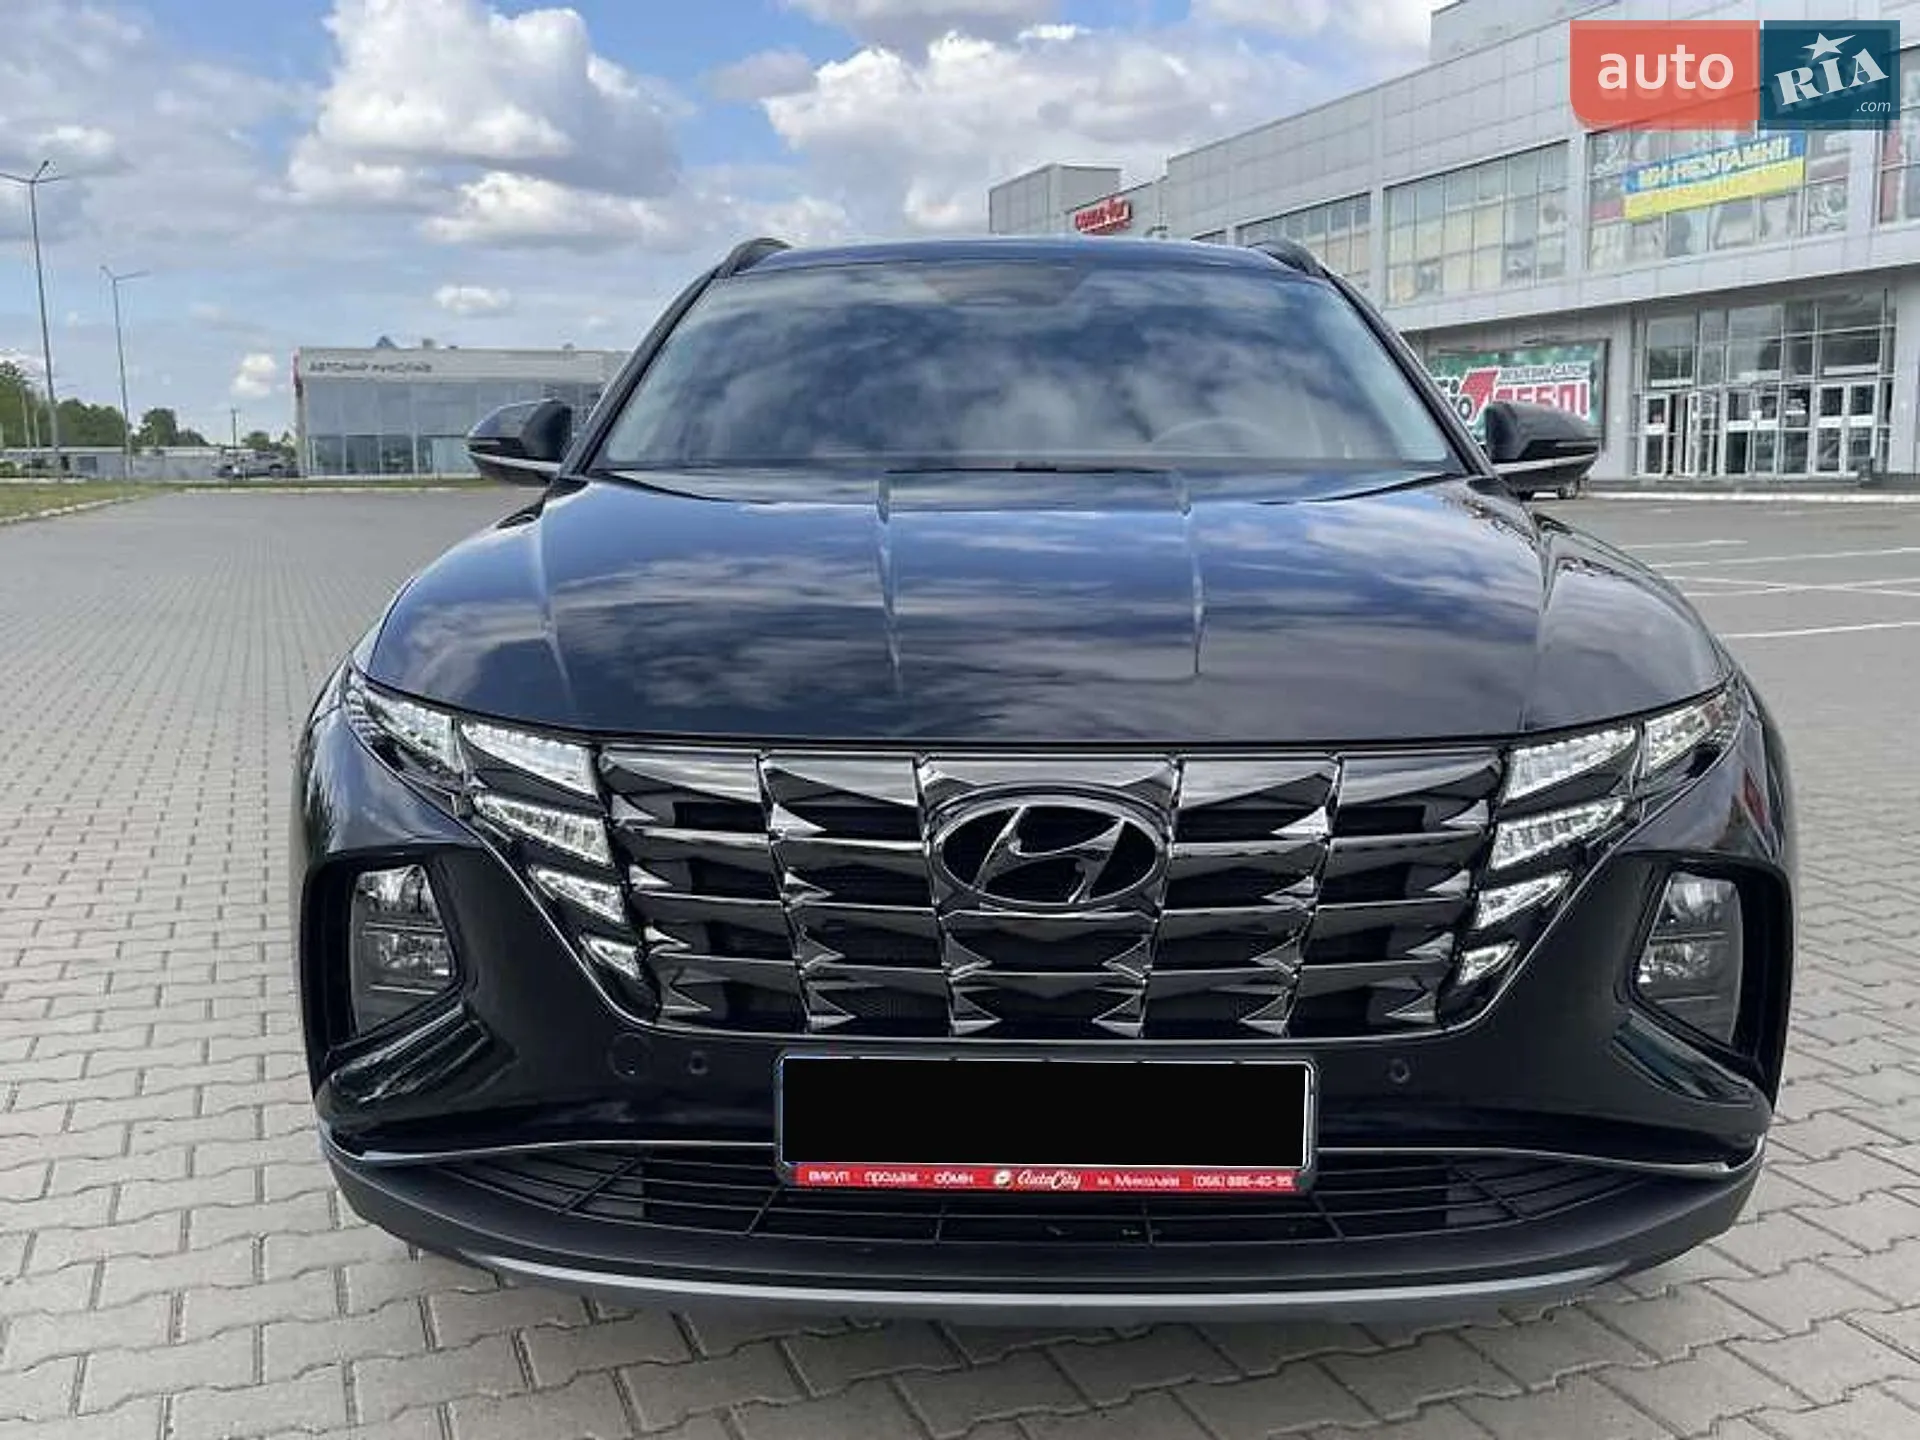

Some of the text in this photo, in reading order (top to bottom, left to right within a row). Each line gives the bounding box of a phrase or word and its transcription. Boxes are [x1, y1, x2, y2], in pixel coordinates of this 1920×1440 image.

[808, 1170, 850, 1184] викуп
[863, 1171, 919, 1186] продаж
[933, 1171, 974, 1186] обмін
[1017, 1169, 1081, 1190] AutoCity
